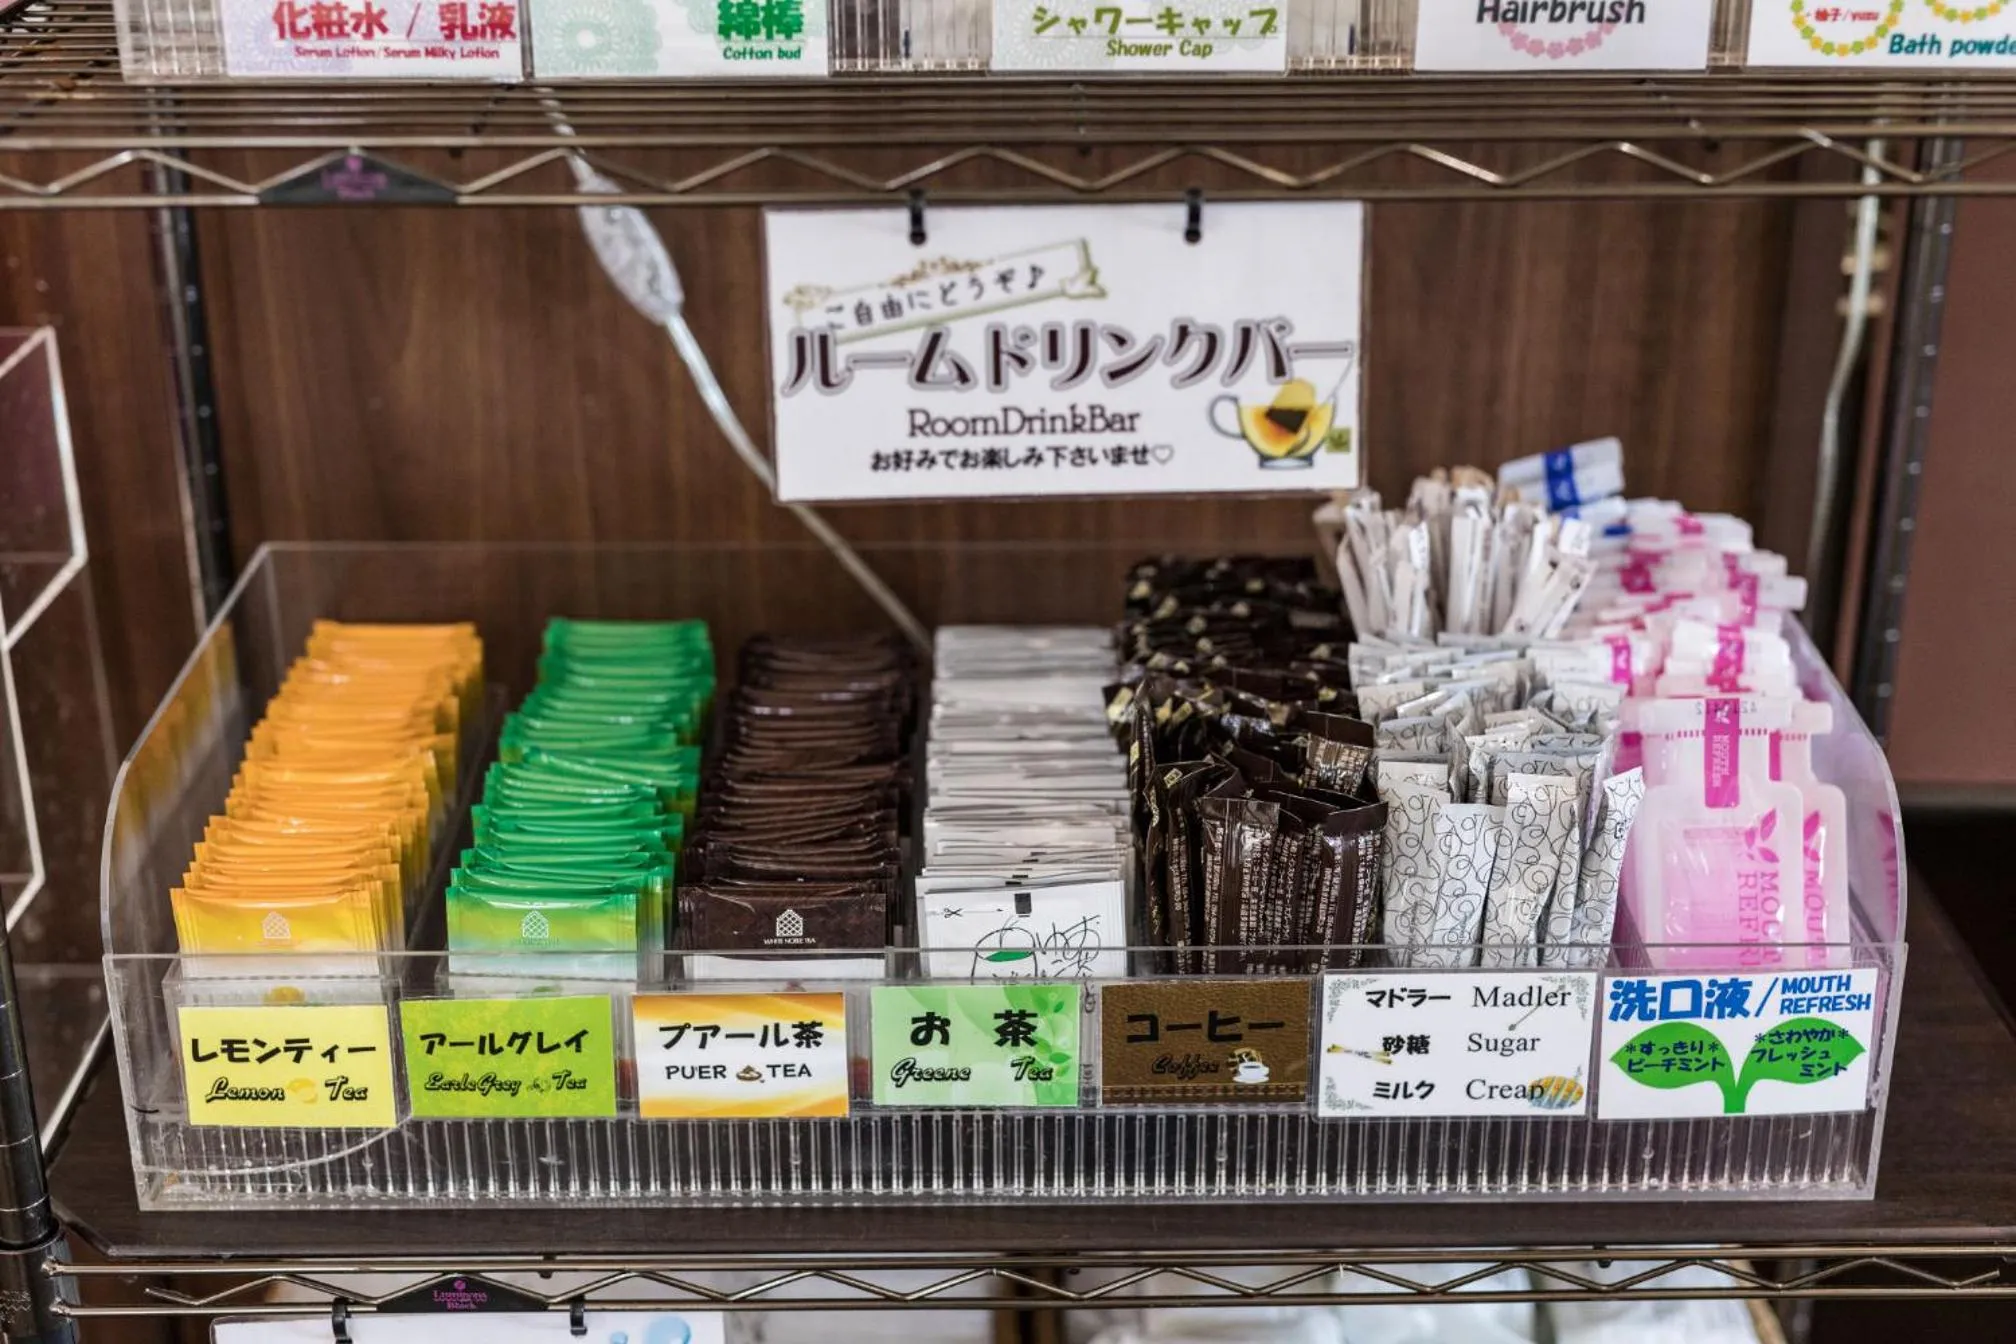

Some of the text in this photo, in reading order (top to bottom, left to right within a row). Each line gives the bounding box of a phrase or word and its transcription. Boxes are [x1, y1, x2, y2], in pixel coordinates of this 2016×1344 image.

[273, 1, 388, 40] 化粧水
[439, 2, 516, 40] 乳液
[1032, 6, 1278, 36] シャワーキャップ
[425, 46, 456, 59] Milky
[460, 46, 500, 59] Lotion
[722, 46, 802, 60] Cotton bud
[1106, 39, 1214, 58] Shower Cap
[1888, 34, 1941, 54] Bath
[780, 317, 1354, 396] ルームドリンクバー
[1781, 974, 1852, 994] MOUTH
[1366, 987, 1452, 1009] マドラー
[1471, 984, 1573, 1009] Madler
[1779, 993, 1872, 1015] REFRESH
[659, 1021, 825, 1050] プアール茶
[1126, 1010, 1286, 1044] コーヒー
[191, 1037, 376, 1065] レモンティー
[419, 1029, 590, 1056] アールグレイ
[1381, 1034, 1431, 1056] 砂糖
[1467, 1032, 1542, 1058] Sugar
[1751, 1045, 1832, 1064] フレッシュ
[765, 1063, 813, 1078] TEA
[1010, 1055, 1054, 1082] Tea
[1151, 1053, 1221, 1080] Coffee
[1798, 1064, 1848, 1078] ミント
[205, 1075, 369, 1104] Lemon Tea
[1372, 1080, 1436, 1100] ミルク
